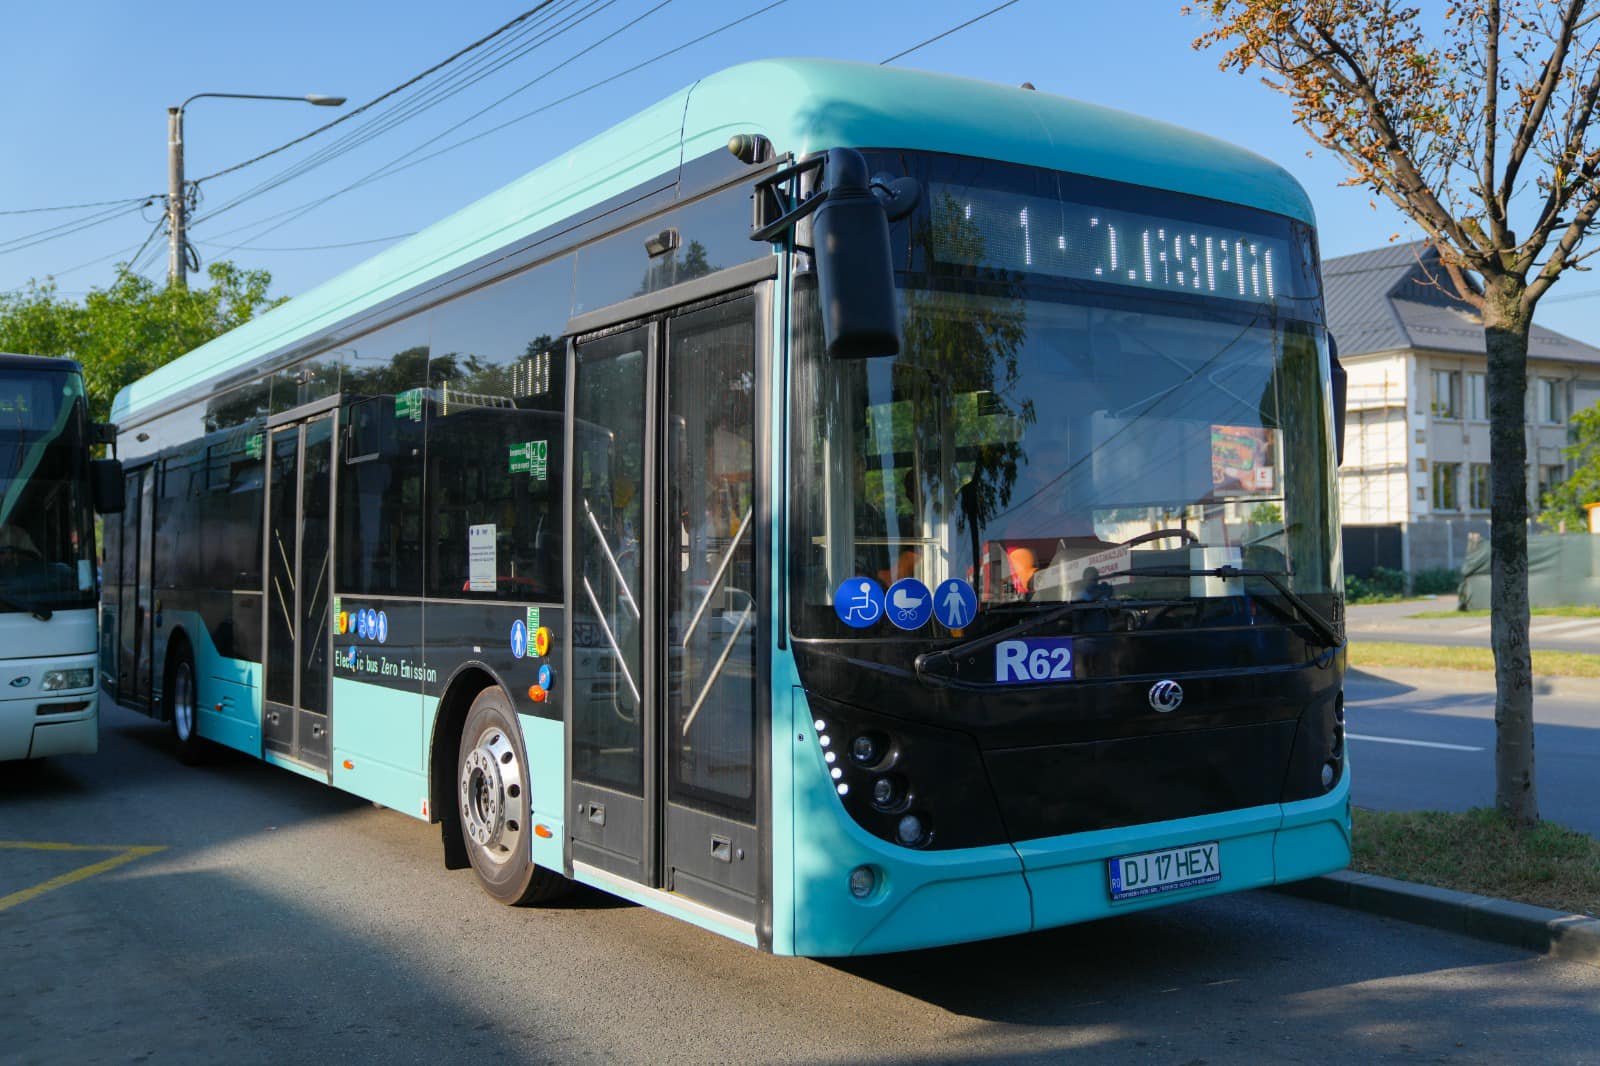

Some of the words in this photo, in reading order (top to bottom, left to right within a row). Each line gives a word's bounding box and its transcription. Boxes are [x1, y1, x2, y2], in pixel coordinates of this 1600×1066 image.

[335, 650, 364, 671] Elecic
[366, 654, 378, 673] bus
[381, 656, 398, 677] Zero
[400, 659, 437, 682] Emission
[996, 640, 1072, 681] R62
[1124, 858, 1149, 887] DJ
[1155, 853, 1172, 881] 17
[1176, 846, 1215, 877] HEX
